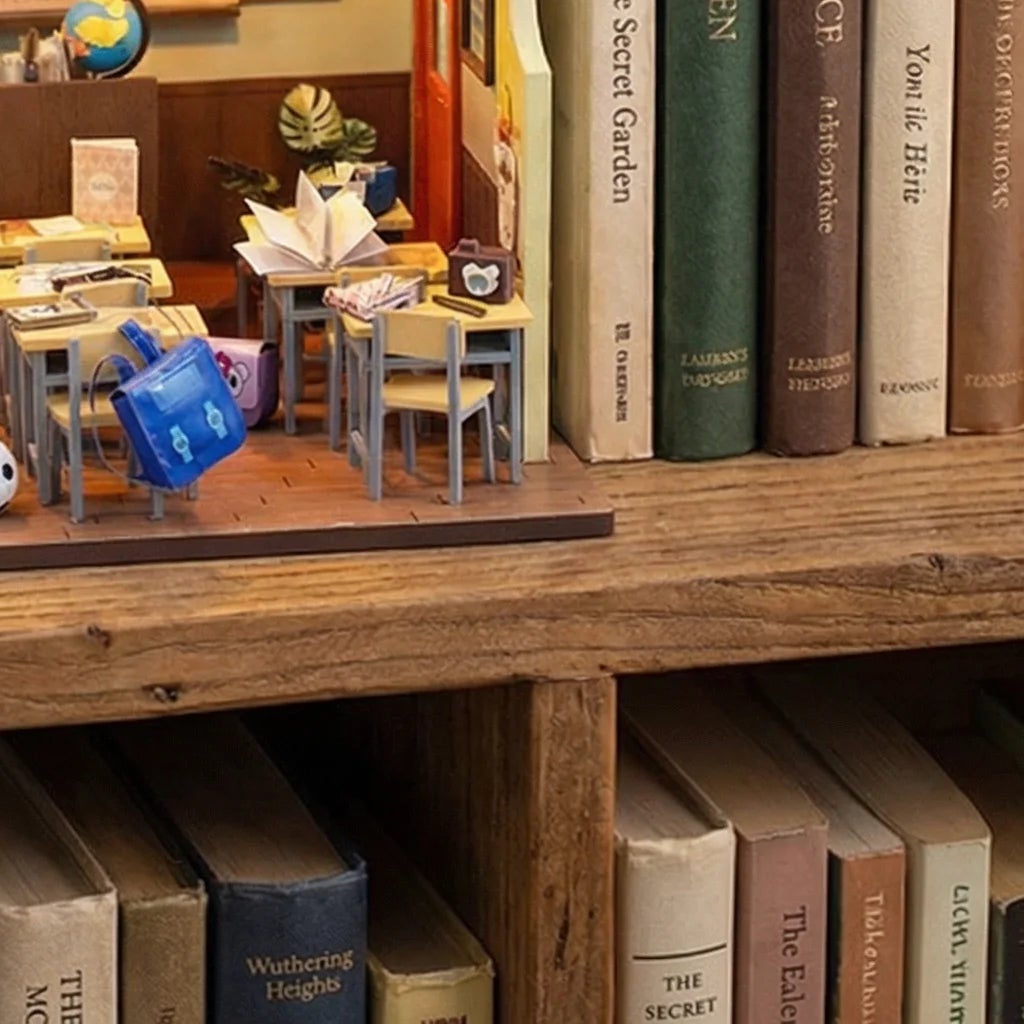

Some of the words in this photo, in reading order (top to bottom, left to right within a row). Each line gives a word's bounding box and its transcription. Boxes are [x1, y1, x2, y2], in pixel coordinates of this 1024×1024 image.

[613, 18, 638, 99] Secret
[613, 107, 638, 204] Garden
[782, 905, 807, 957] The
[246, 949, 354, 975] Wuthering
[662, 972, 703, 992] THE
[265, 975, 342, 1003] Heights
[644, 996, 718, 1021] SECRET
[780, 964, 806, 1024] Eale
